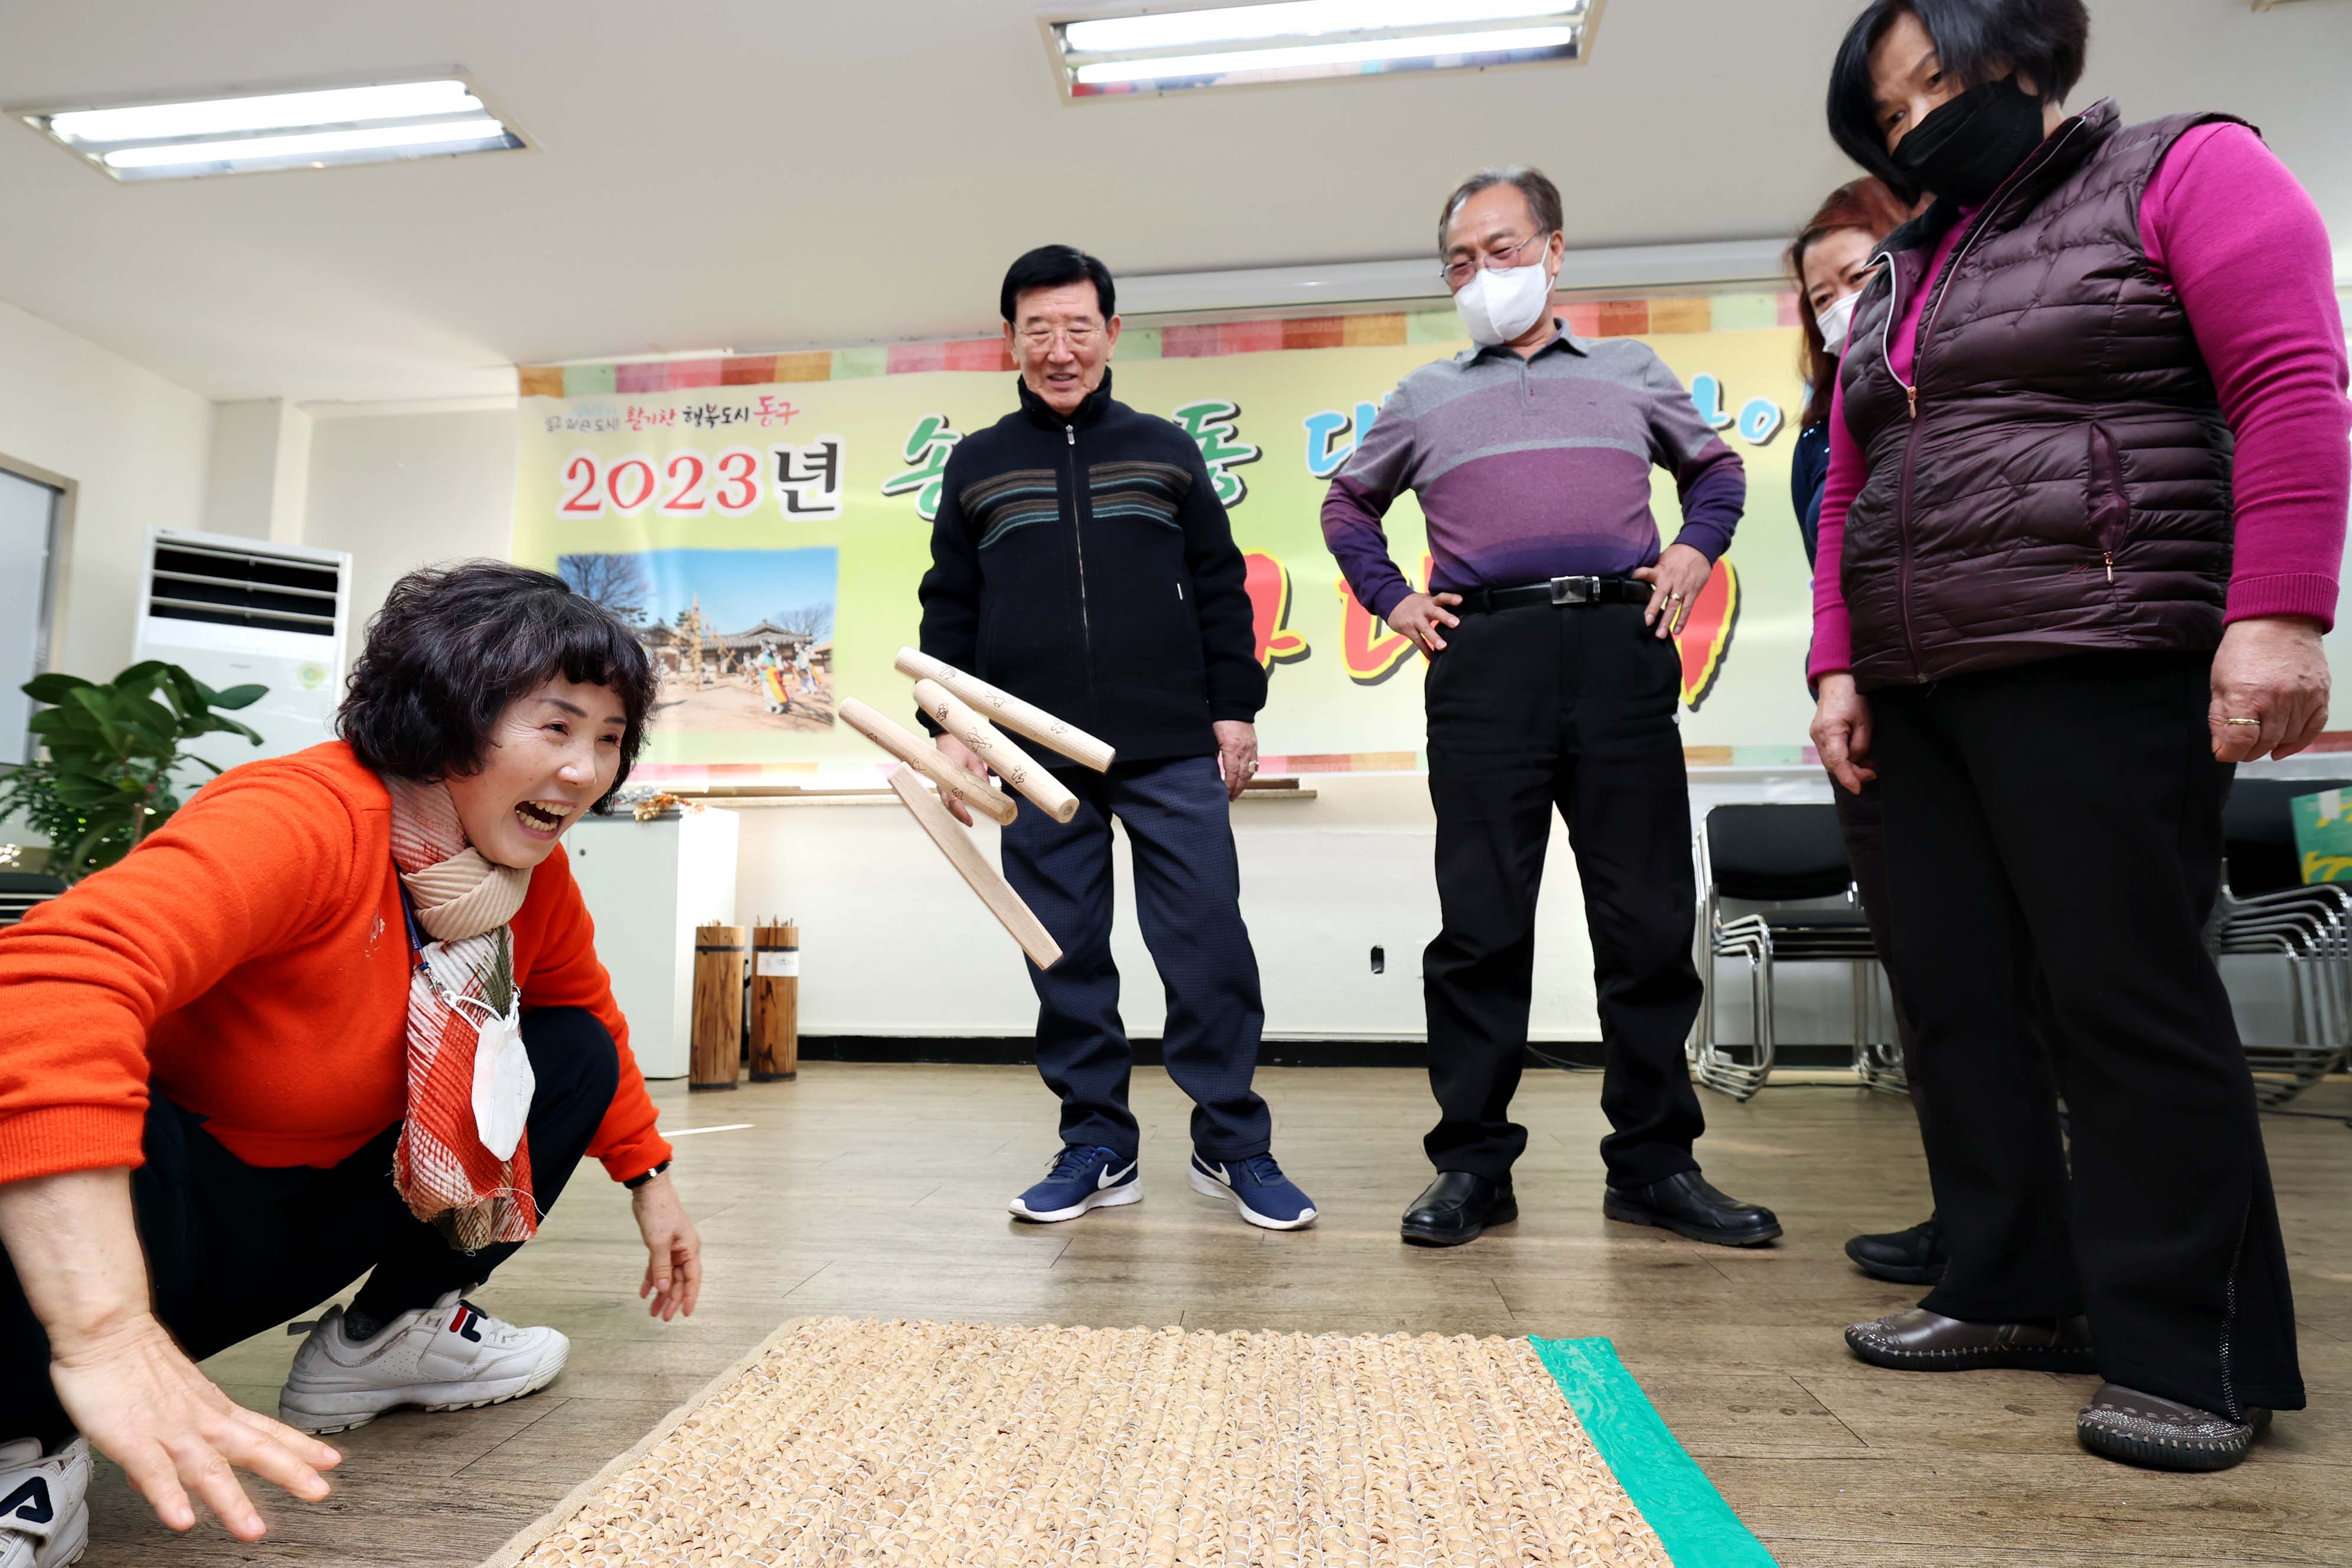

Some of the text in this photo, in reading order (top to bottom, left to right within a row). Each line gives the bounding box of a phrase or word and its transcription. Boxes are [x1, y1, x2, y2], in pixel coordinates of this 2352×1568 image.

[625, 406, 677, 432] 활기찬
[683, 403, 750, 429] 행복도시
[753, 396, 801, 427] 동구
[562, 440, 838, 514] 2023년
